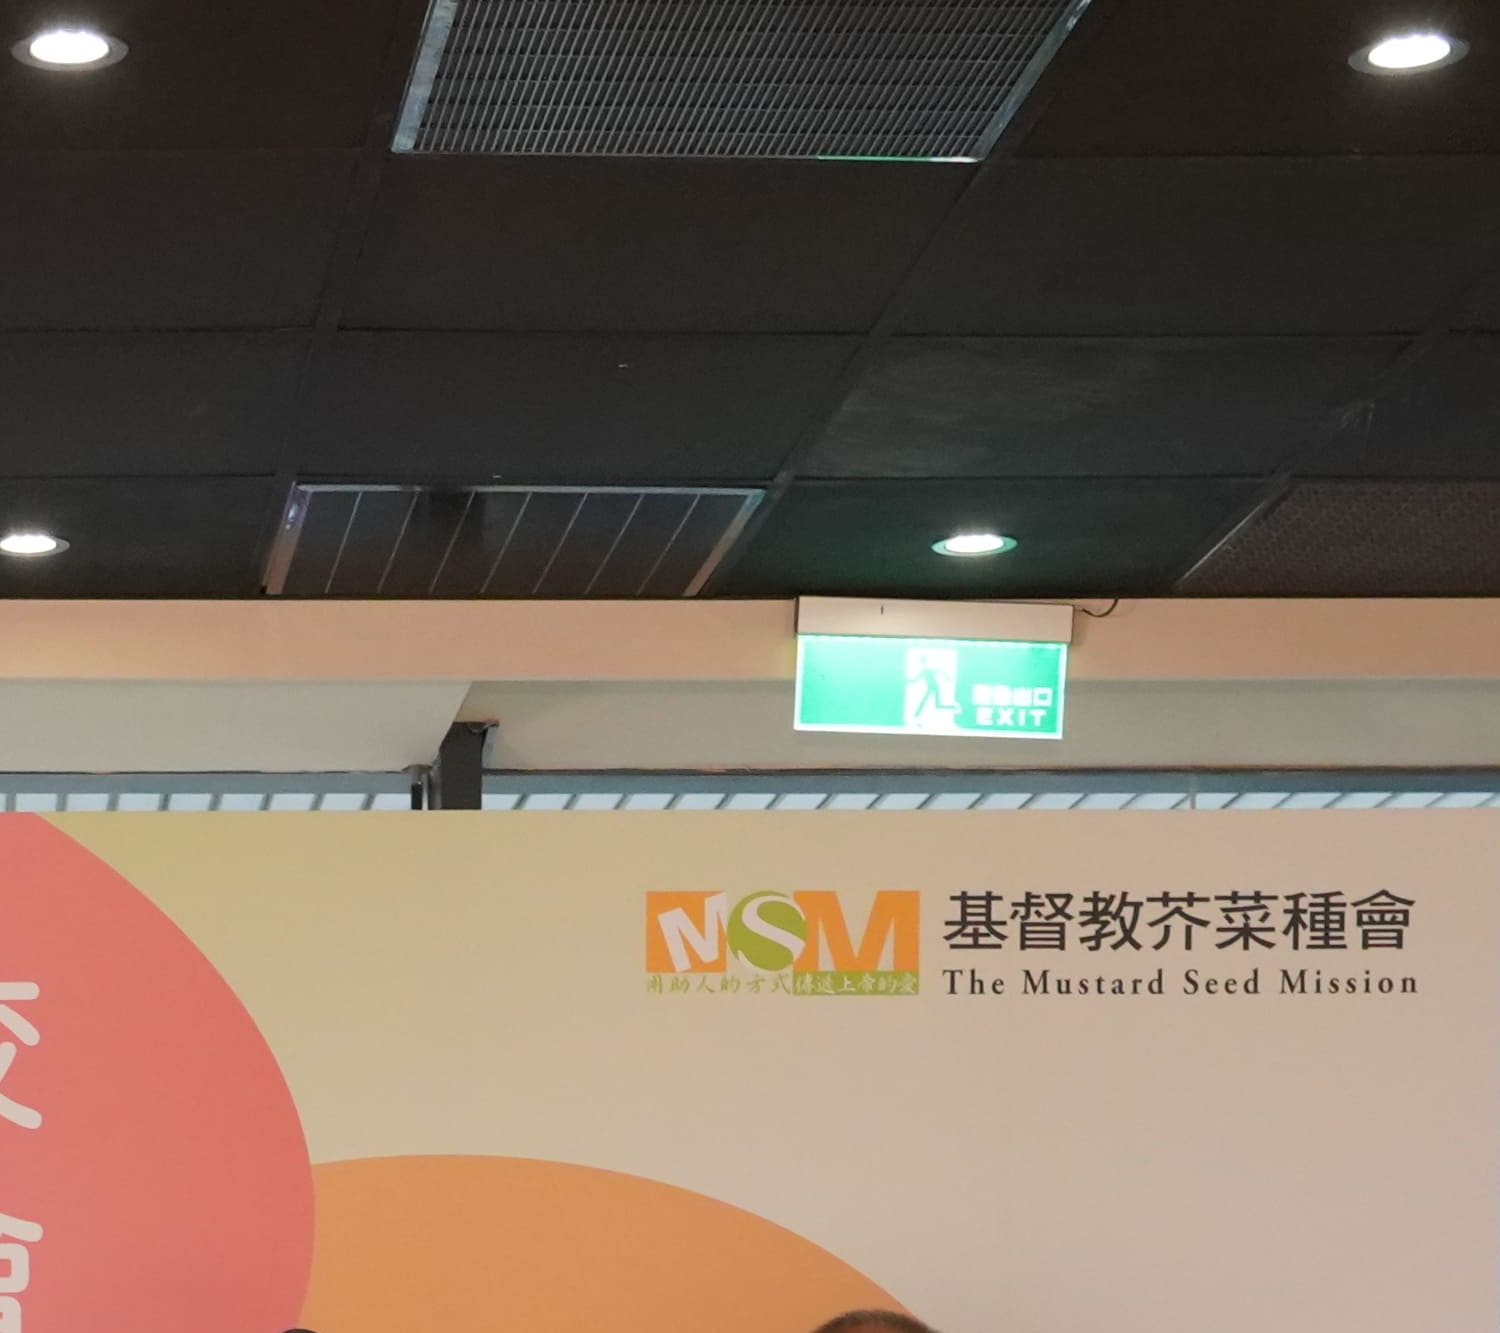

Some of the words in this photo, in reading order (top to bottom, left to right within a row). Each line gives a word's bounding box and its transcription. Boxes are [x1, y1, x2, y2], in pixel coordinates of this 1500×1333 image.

[976, 706, 1047, 727] EXIT
[942, 888, 1416, 951] 基督教芥菜種會
[942, 968, 1006, 995] The
[1022, 968, 1165, 995] Mustard
[1183, 968, 1261, 995] Seed
[1280, 968, 1419, 995] Mission
